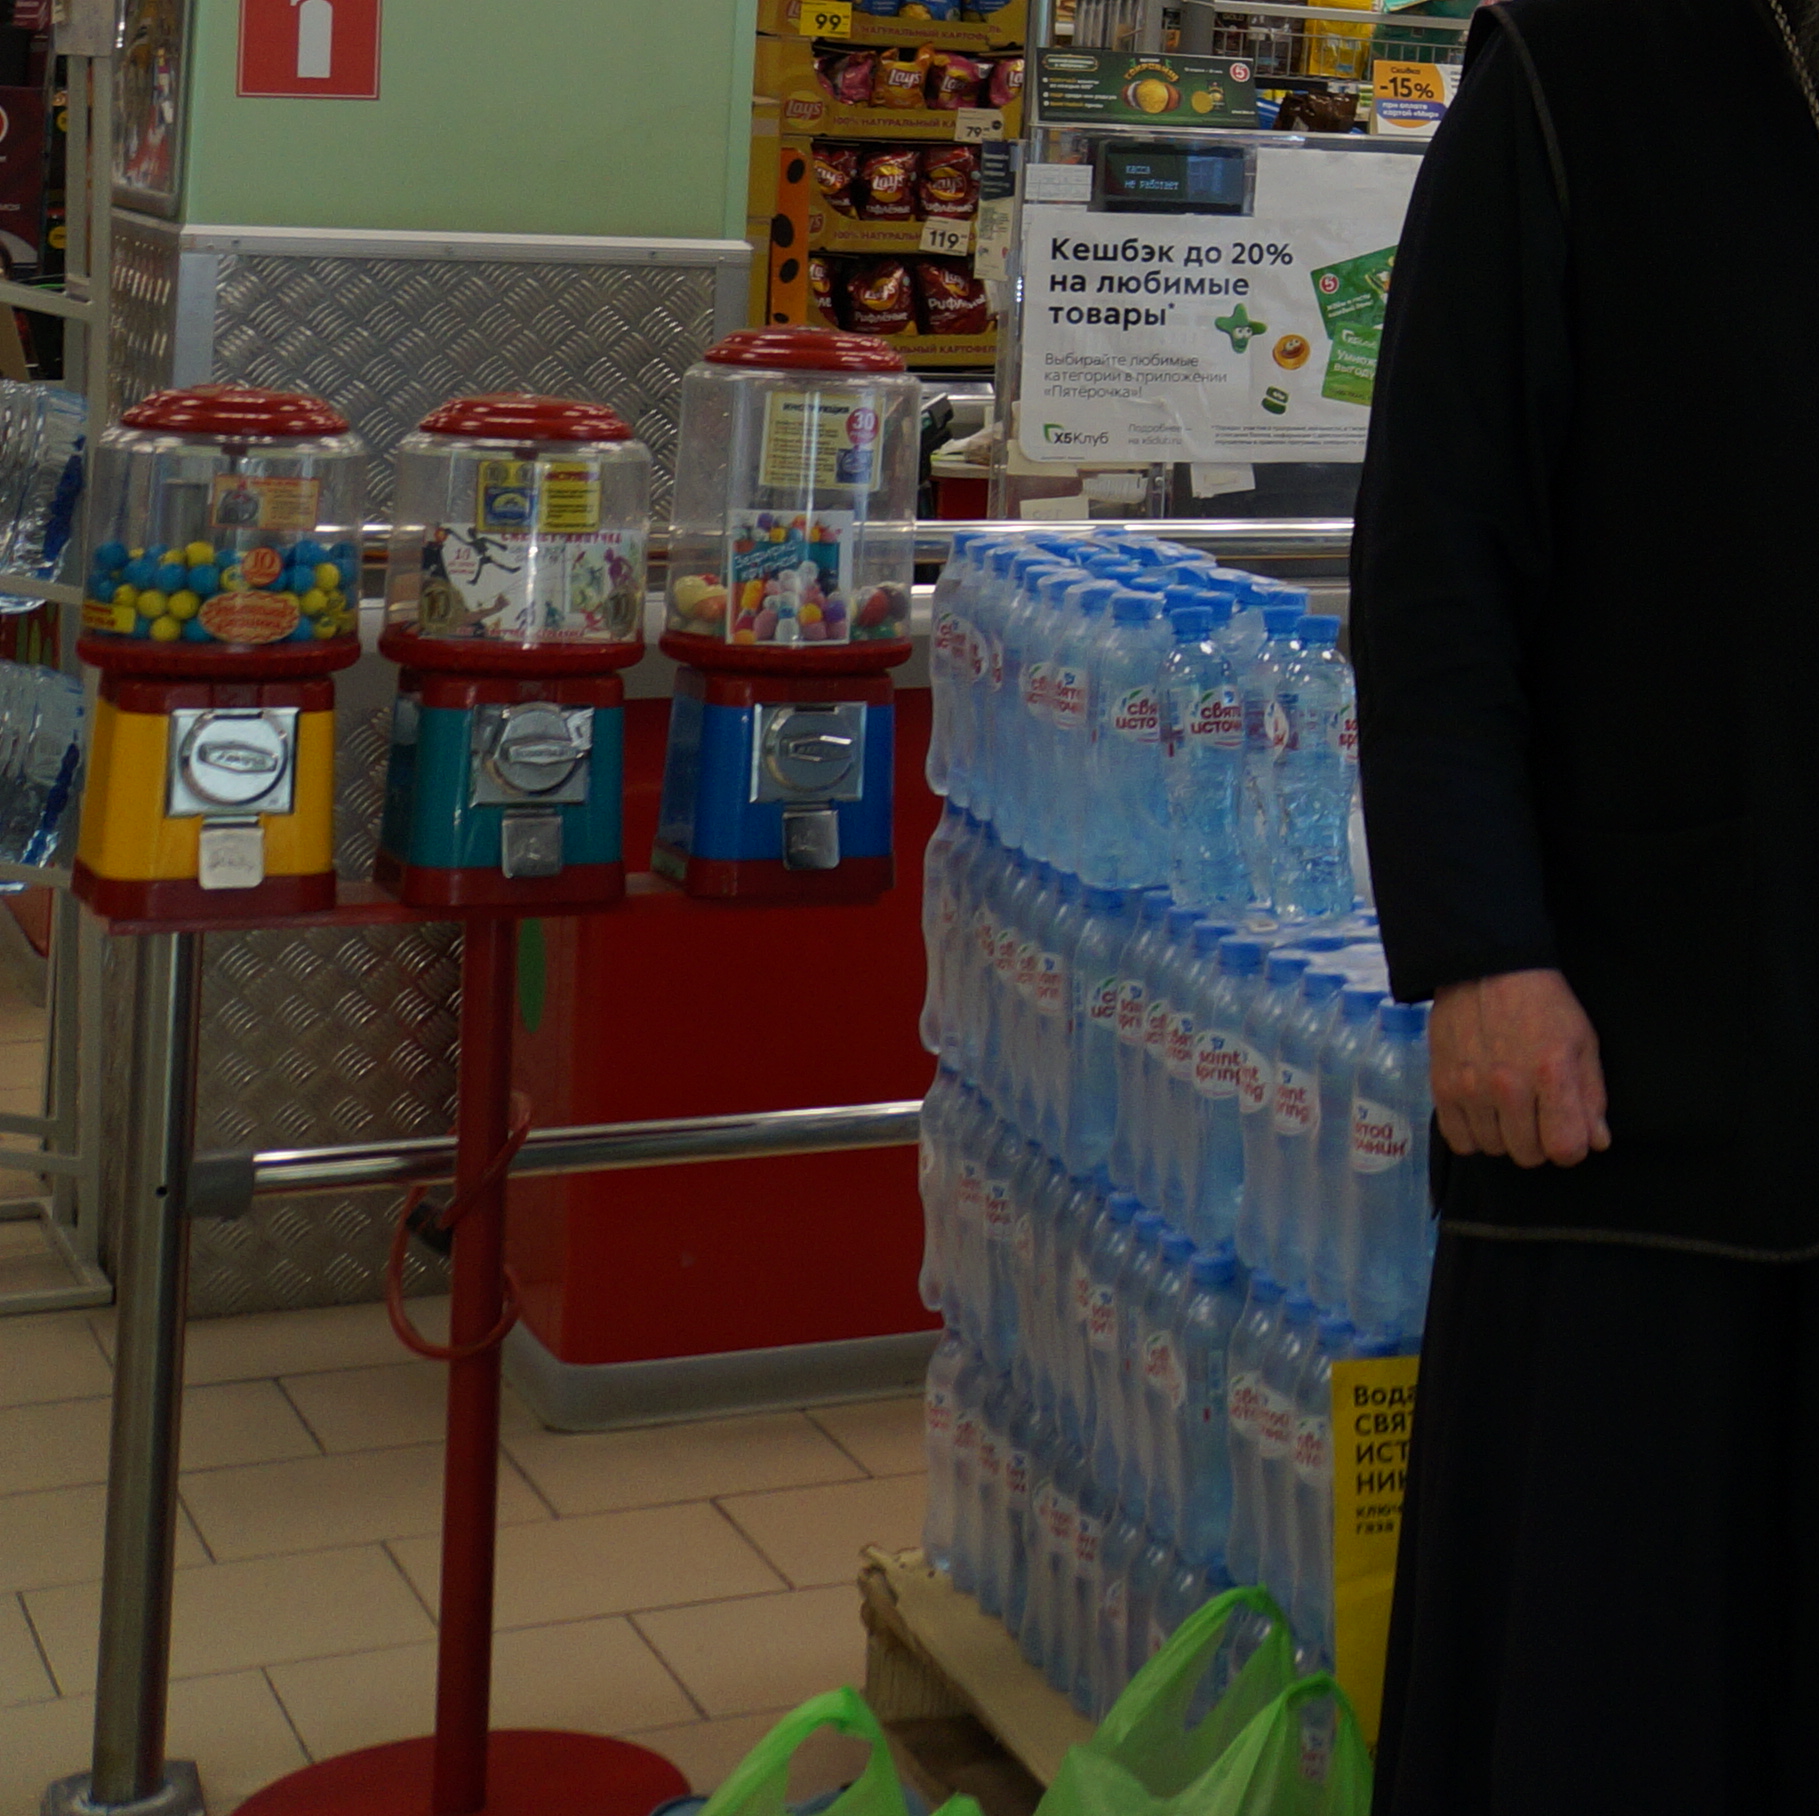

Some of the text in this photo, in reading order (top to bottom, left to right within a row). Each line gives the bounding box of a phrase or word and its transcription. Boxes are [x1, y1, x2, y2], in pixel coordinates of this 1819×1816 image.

[814, 13, 843, 31] 99
[1379, 77, 1435, 100] -15%
[929, 230, 960, 249] 119
[1050, 237, 1294, 268] Кешбэк до 20%
[1049, 272, 1250, 296] на любимые
[1044, 352, 1199, 368] Выбирайте любимые
[1043, 371, 1228, 385] категории приложении
[853, 411, 875, 431] 30
